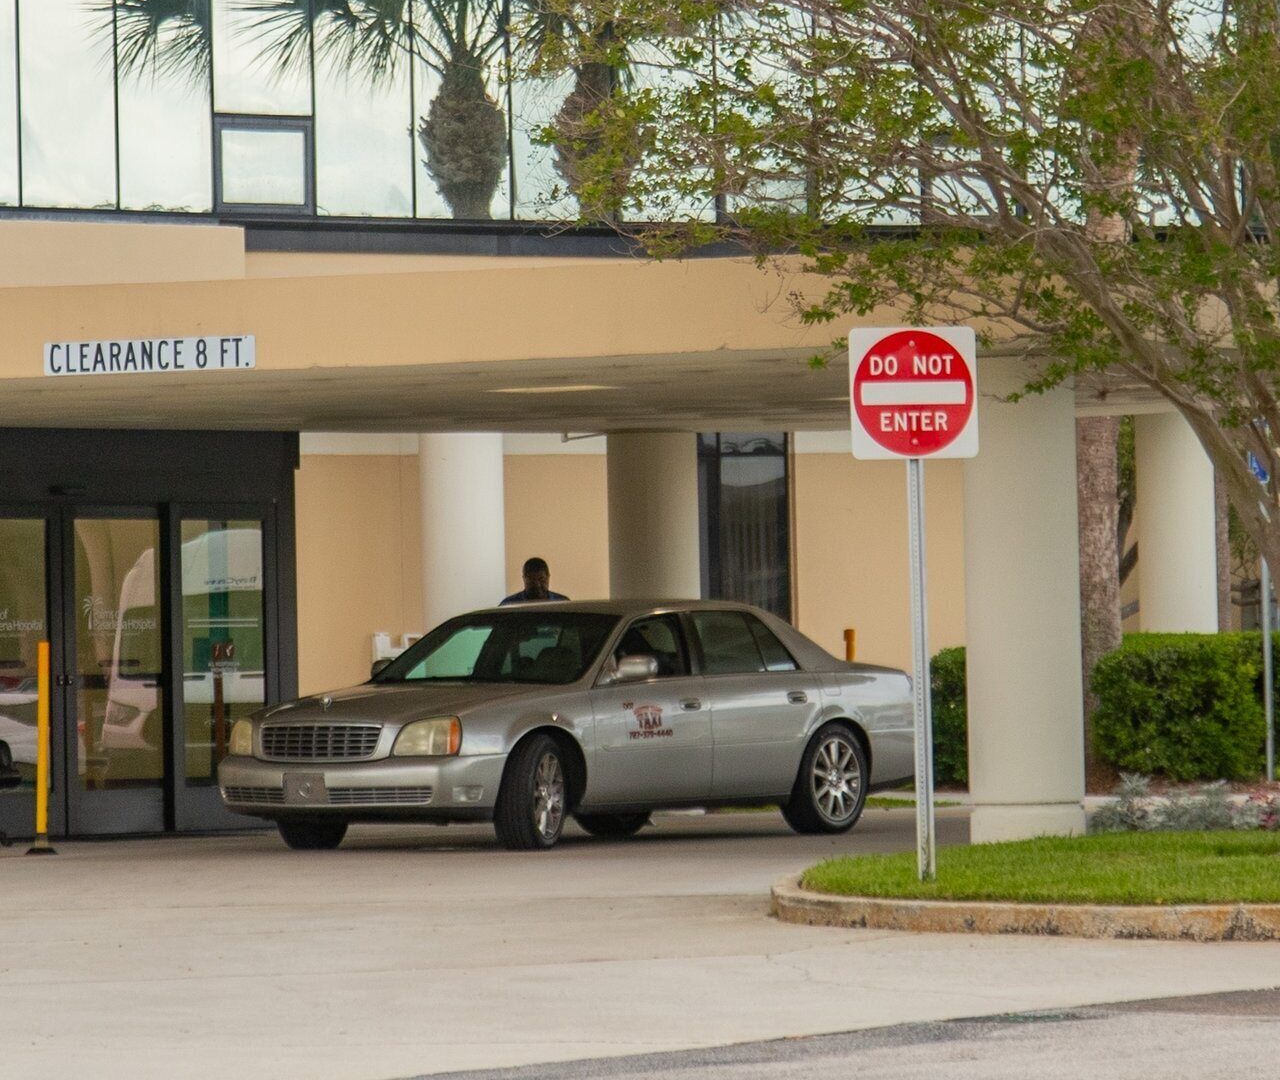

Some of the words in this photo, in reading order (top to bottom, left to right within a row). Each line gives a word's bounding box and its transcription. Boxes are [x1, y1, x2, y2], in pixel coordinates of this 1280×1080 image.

[49, 339, 185, 374] CLEARANCE
[195, 338, 208, 369] 8
[220, 337, 250, 368] FT.
[869, 355, 898, 376] DO
[913, 354, 954, 375] NOT
[880, 411, 948, 432] ENTER
[0, 607, 9, 621] of
